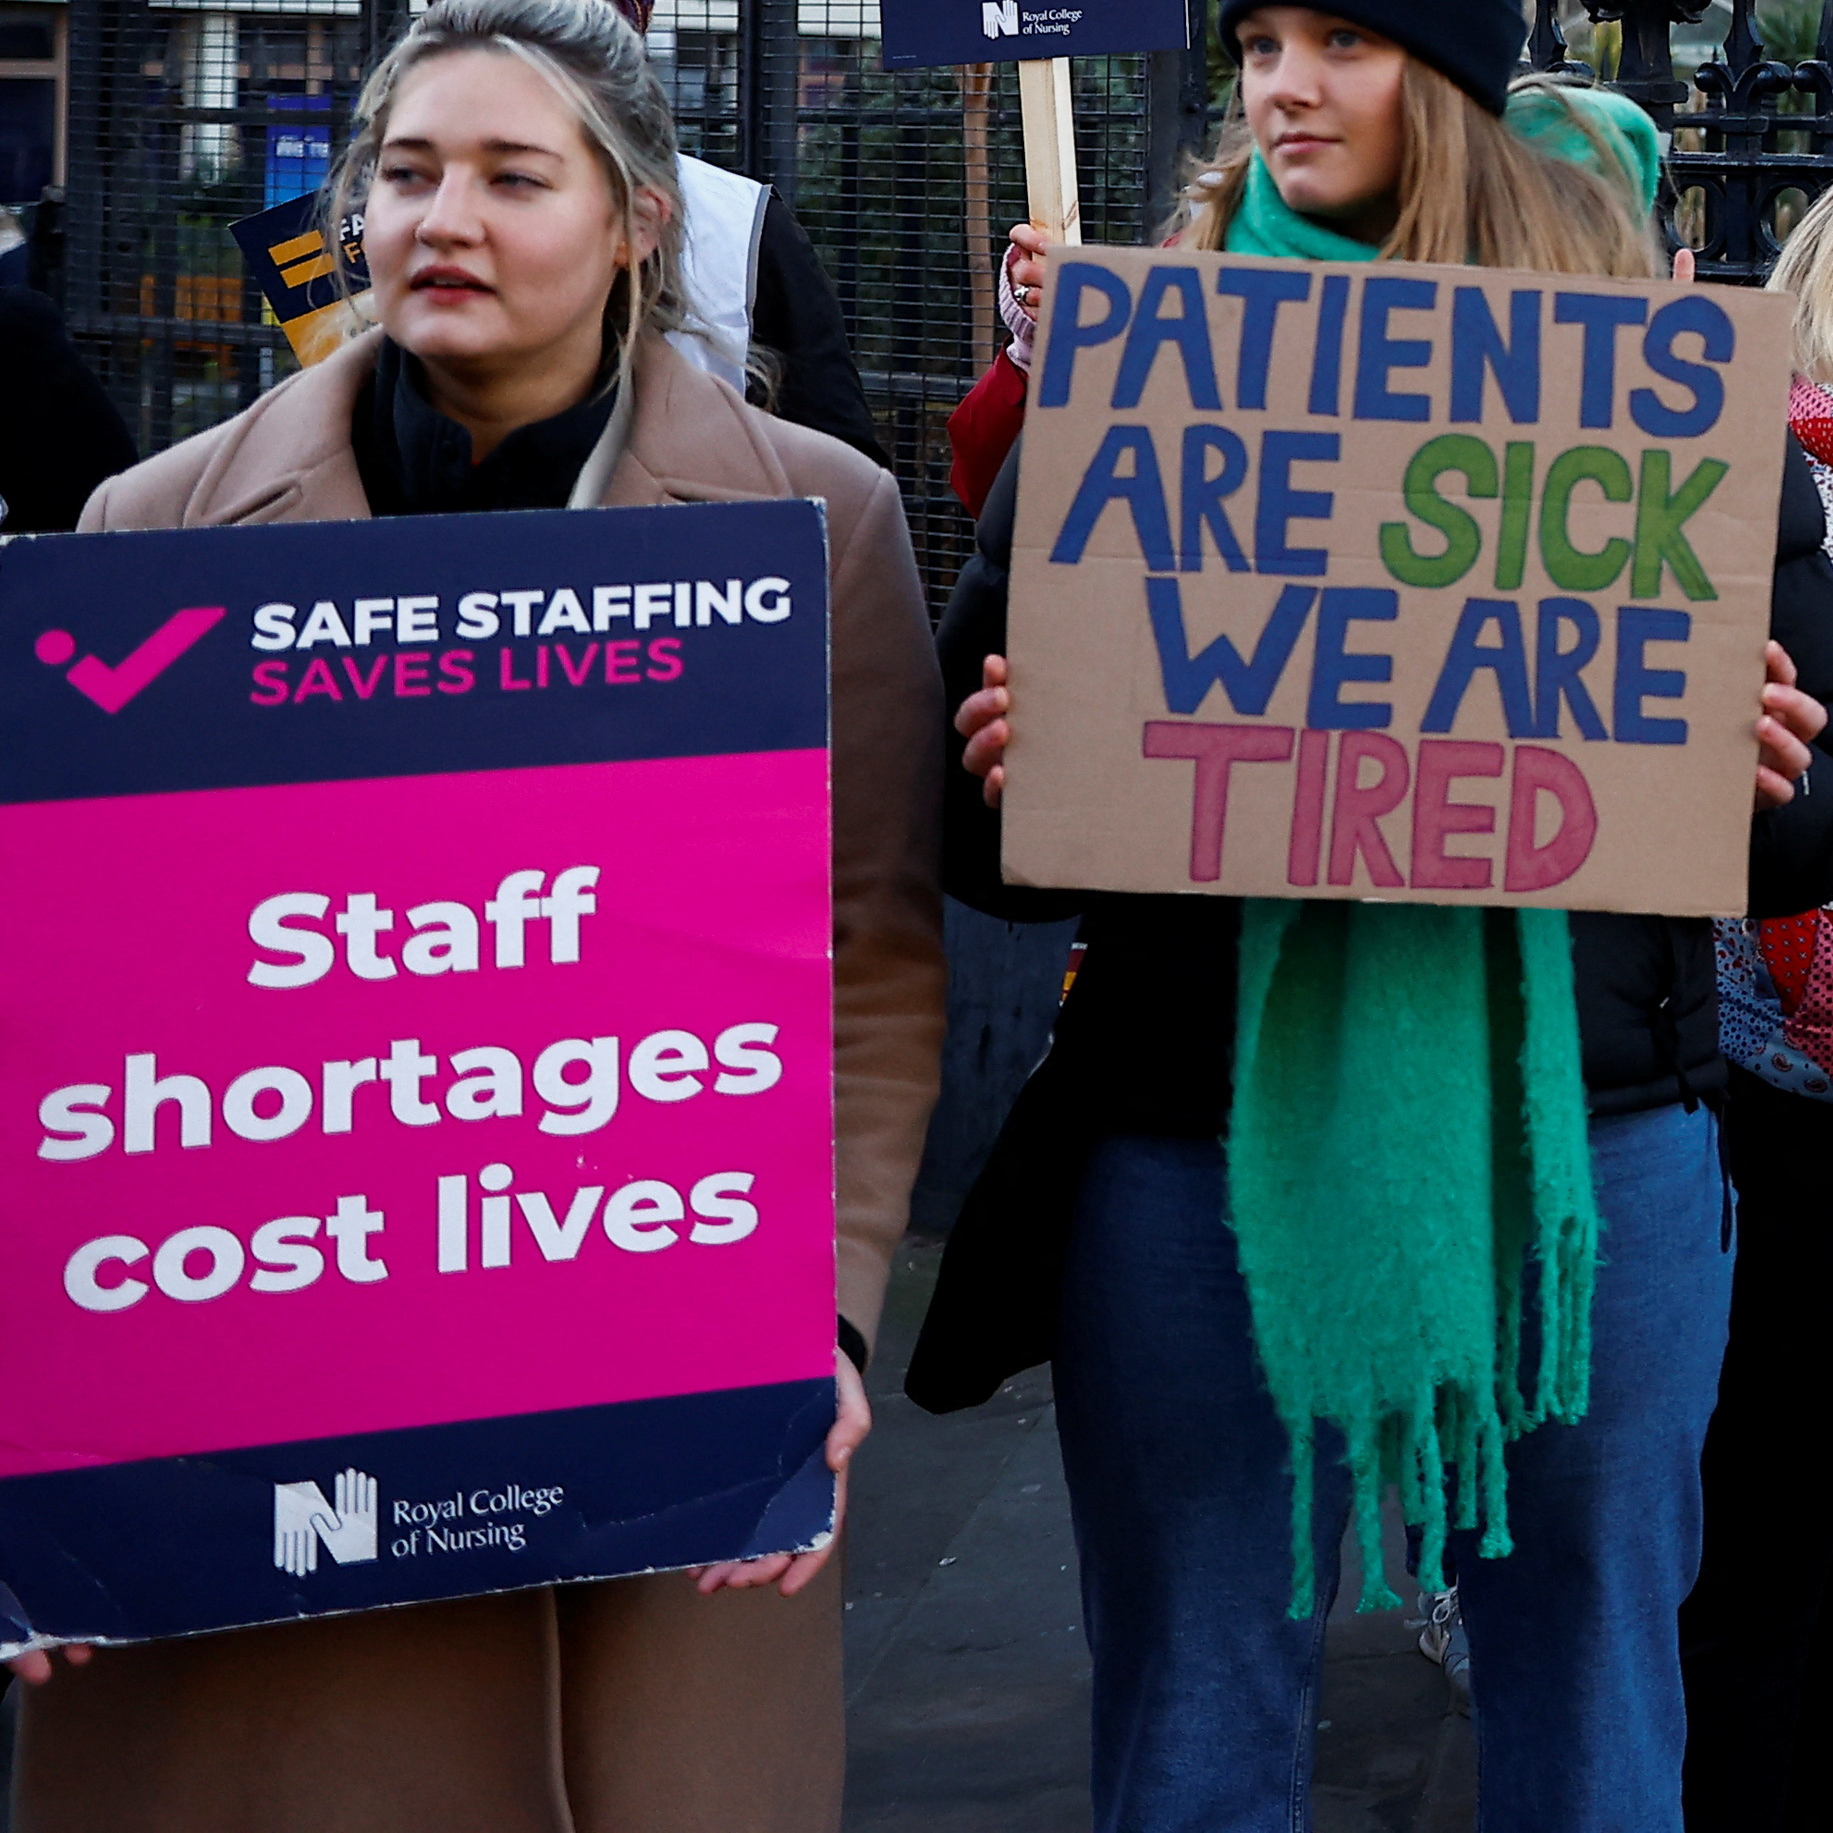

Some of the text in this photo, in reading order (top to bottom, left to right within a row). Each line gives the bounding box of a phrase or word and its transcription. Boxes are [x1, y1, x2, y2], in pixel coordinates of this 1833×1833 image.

[1022, 8, 1082, 25] Royal College
[1022, 22, 1070, 36] of Nursing
[1037, 262, 1735, 439] PATIENTS
[1048, 422, 1730, 602] ARE SICK
[250, 577, 792, 652] SAFE STAFFING
[250, 638, 684, 707] SAVES LIVES
[1144, 575, 1693, 746] WE ARE
[1143, 721, 1598, 893] TIRED
[246, 867, 600, 991] Staff
[35, 1023, 784, 1164] shortages
[63, 1163, 760, 1314] cost lives
[391, 1519, 527, 1558] of Nursing
[392, 1482, 565, 1528] Royal College
